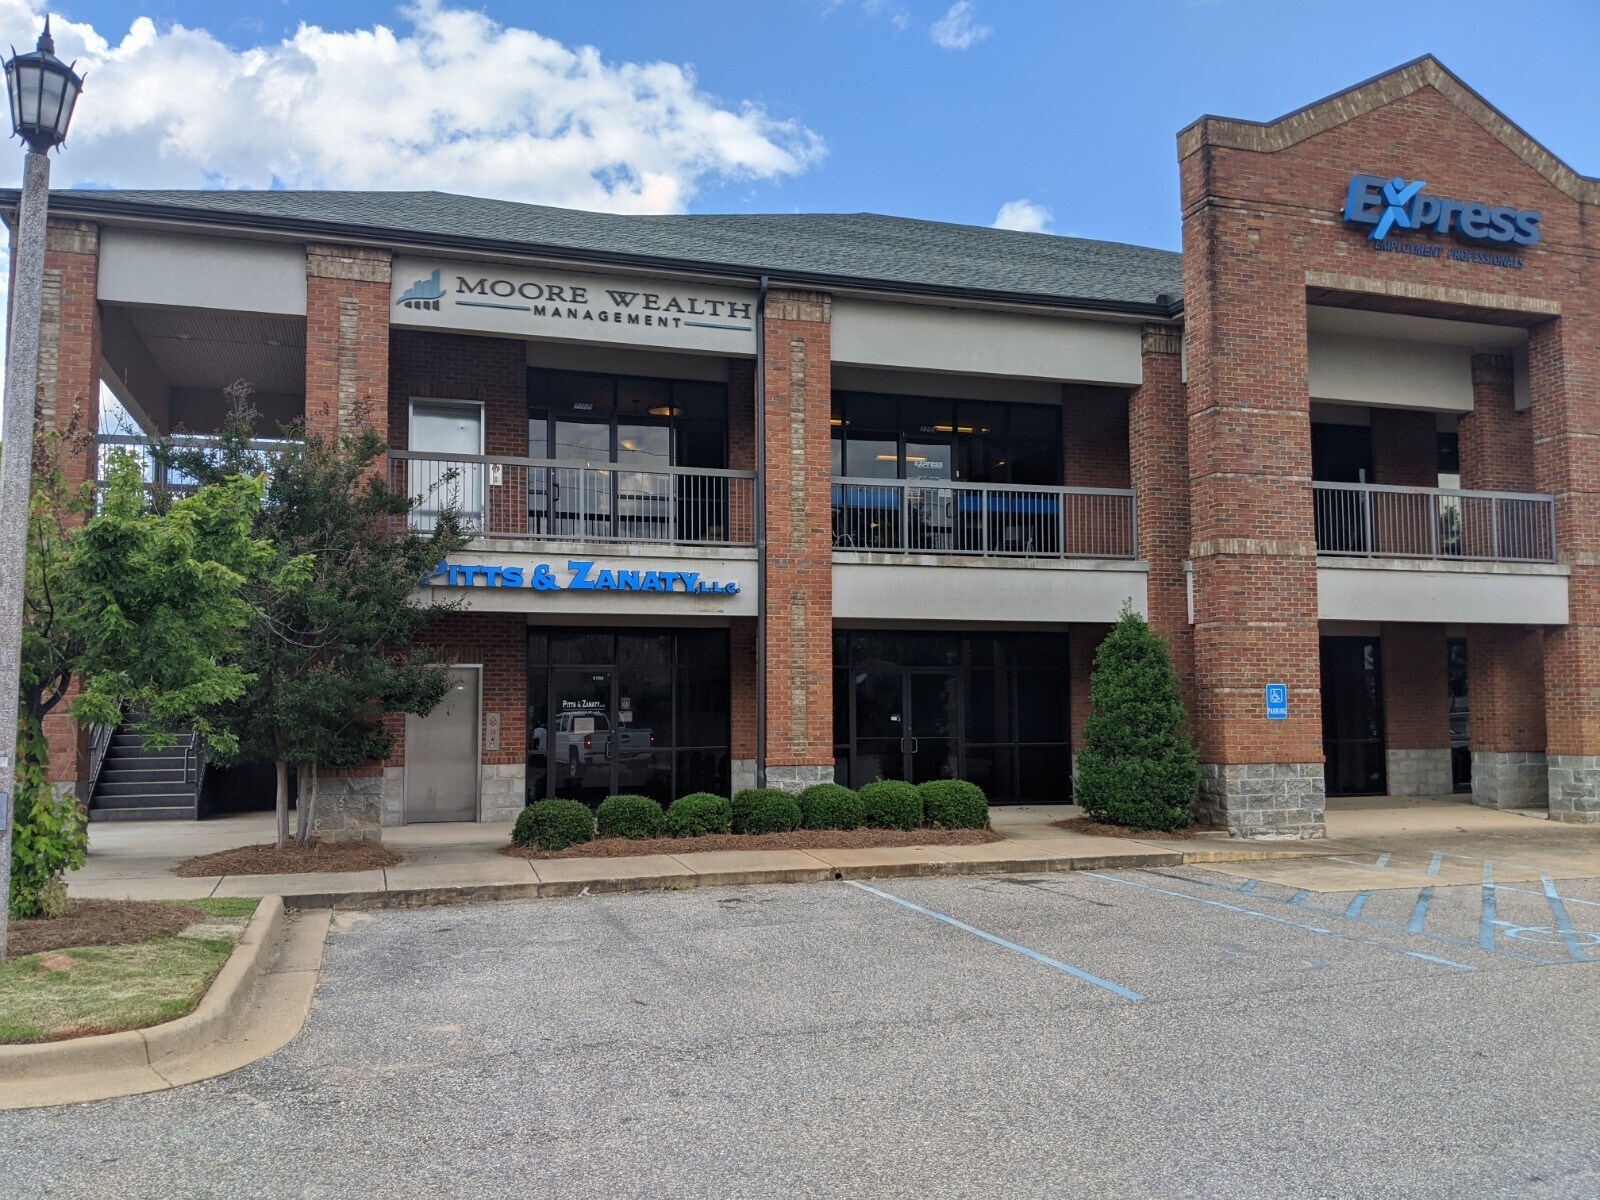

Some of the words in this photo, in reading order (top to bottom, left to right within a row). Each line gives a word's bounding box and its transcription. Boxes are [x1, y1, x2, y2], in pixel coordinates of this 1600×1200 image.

[1374, 239, 1443, 259] EMPLOYMENT
[1446, 249, 1525, 269] PROFESSIONALS
[456, 276, 588, 303] MOORE
[605, 290, 752, 320] WEALTH
[534, 304, 681, 329] MANAGEMENT
[531, 564, 560, 591] &
